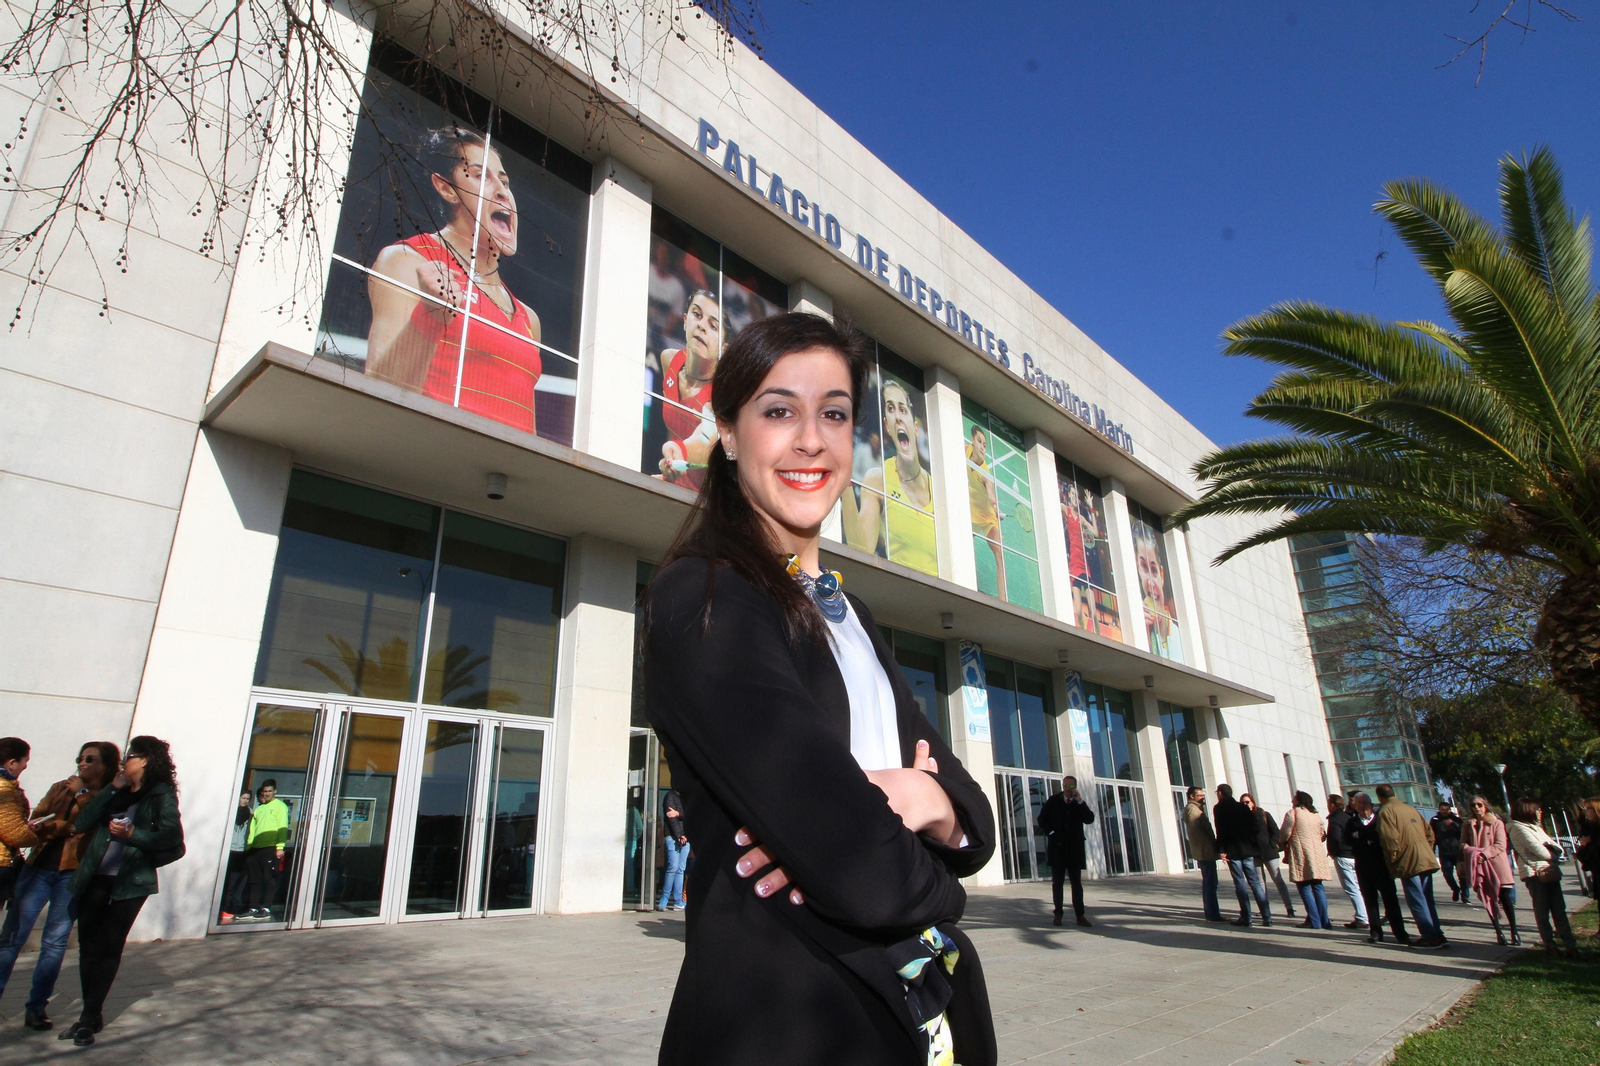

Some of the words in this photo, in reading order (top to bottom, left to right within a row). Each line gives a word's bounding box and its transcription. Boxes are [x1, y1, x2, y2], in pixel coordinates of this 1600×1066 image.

[698, 117, 842, 249] PALACIO
[856, 233, 890, 284] DE
[898, 263, 1011, 368] DEPORTES
[1022, 352, 1092, 425] Carolina
[1092, 403, 1134, 455] Marín
